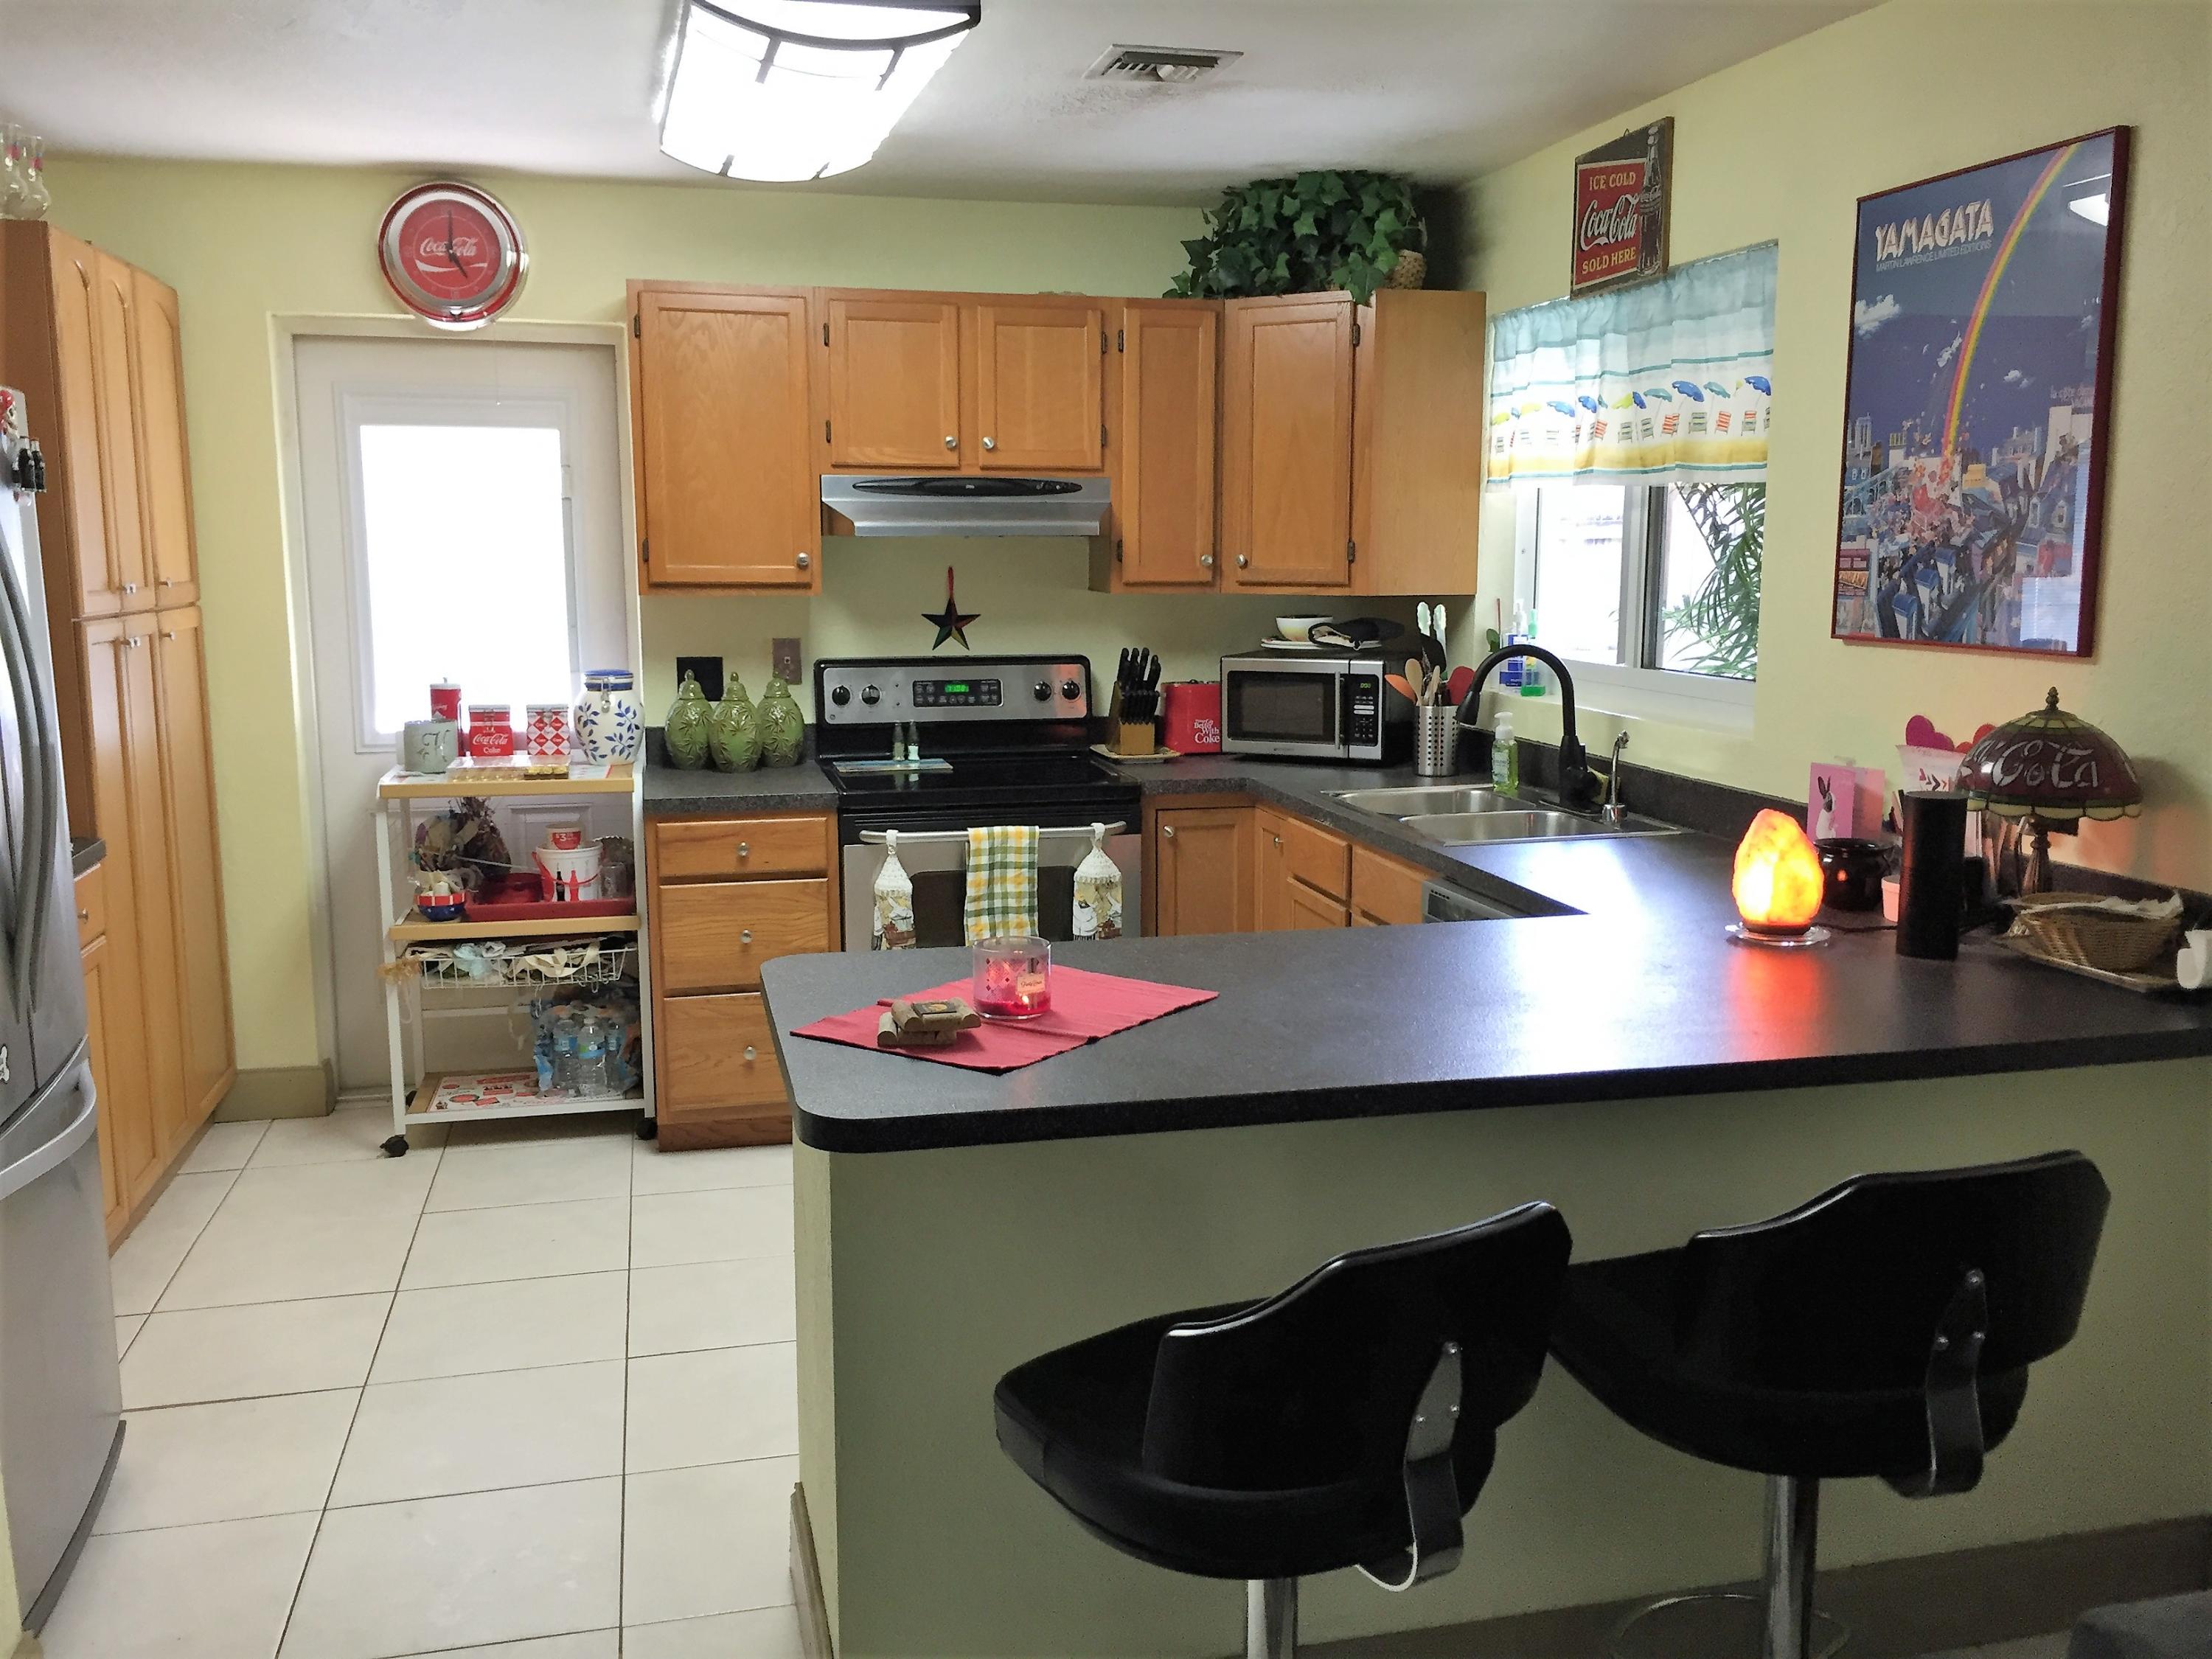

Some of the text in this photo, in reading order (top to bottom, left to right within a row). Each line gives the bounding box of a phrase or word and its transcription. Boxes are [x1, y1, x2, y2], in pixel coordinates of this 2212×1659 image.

[1589, 172, 1636, 191] ICE COLD
[1875, 198, 1994, 262] YAMAGATA
[420, 237, 479, 257] CocaCola
[1582, 247, 1636, 274] SOLD HERE
[1876, 258, 1901, 272] MARTIN
[1194, 732, 1220, 744] Coke
